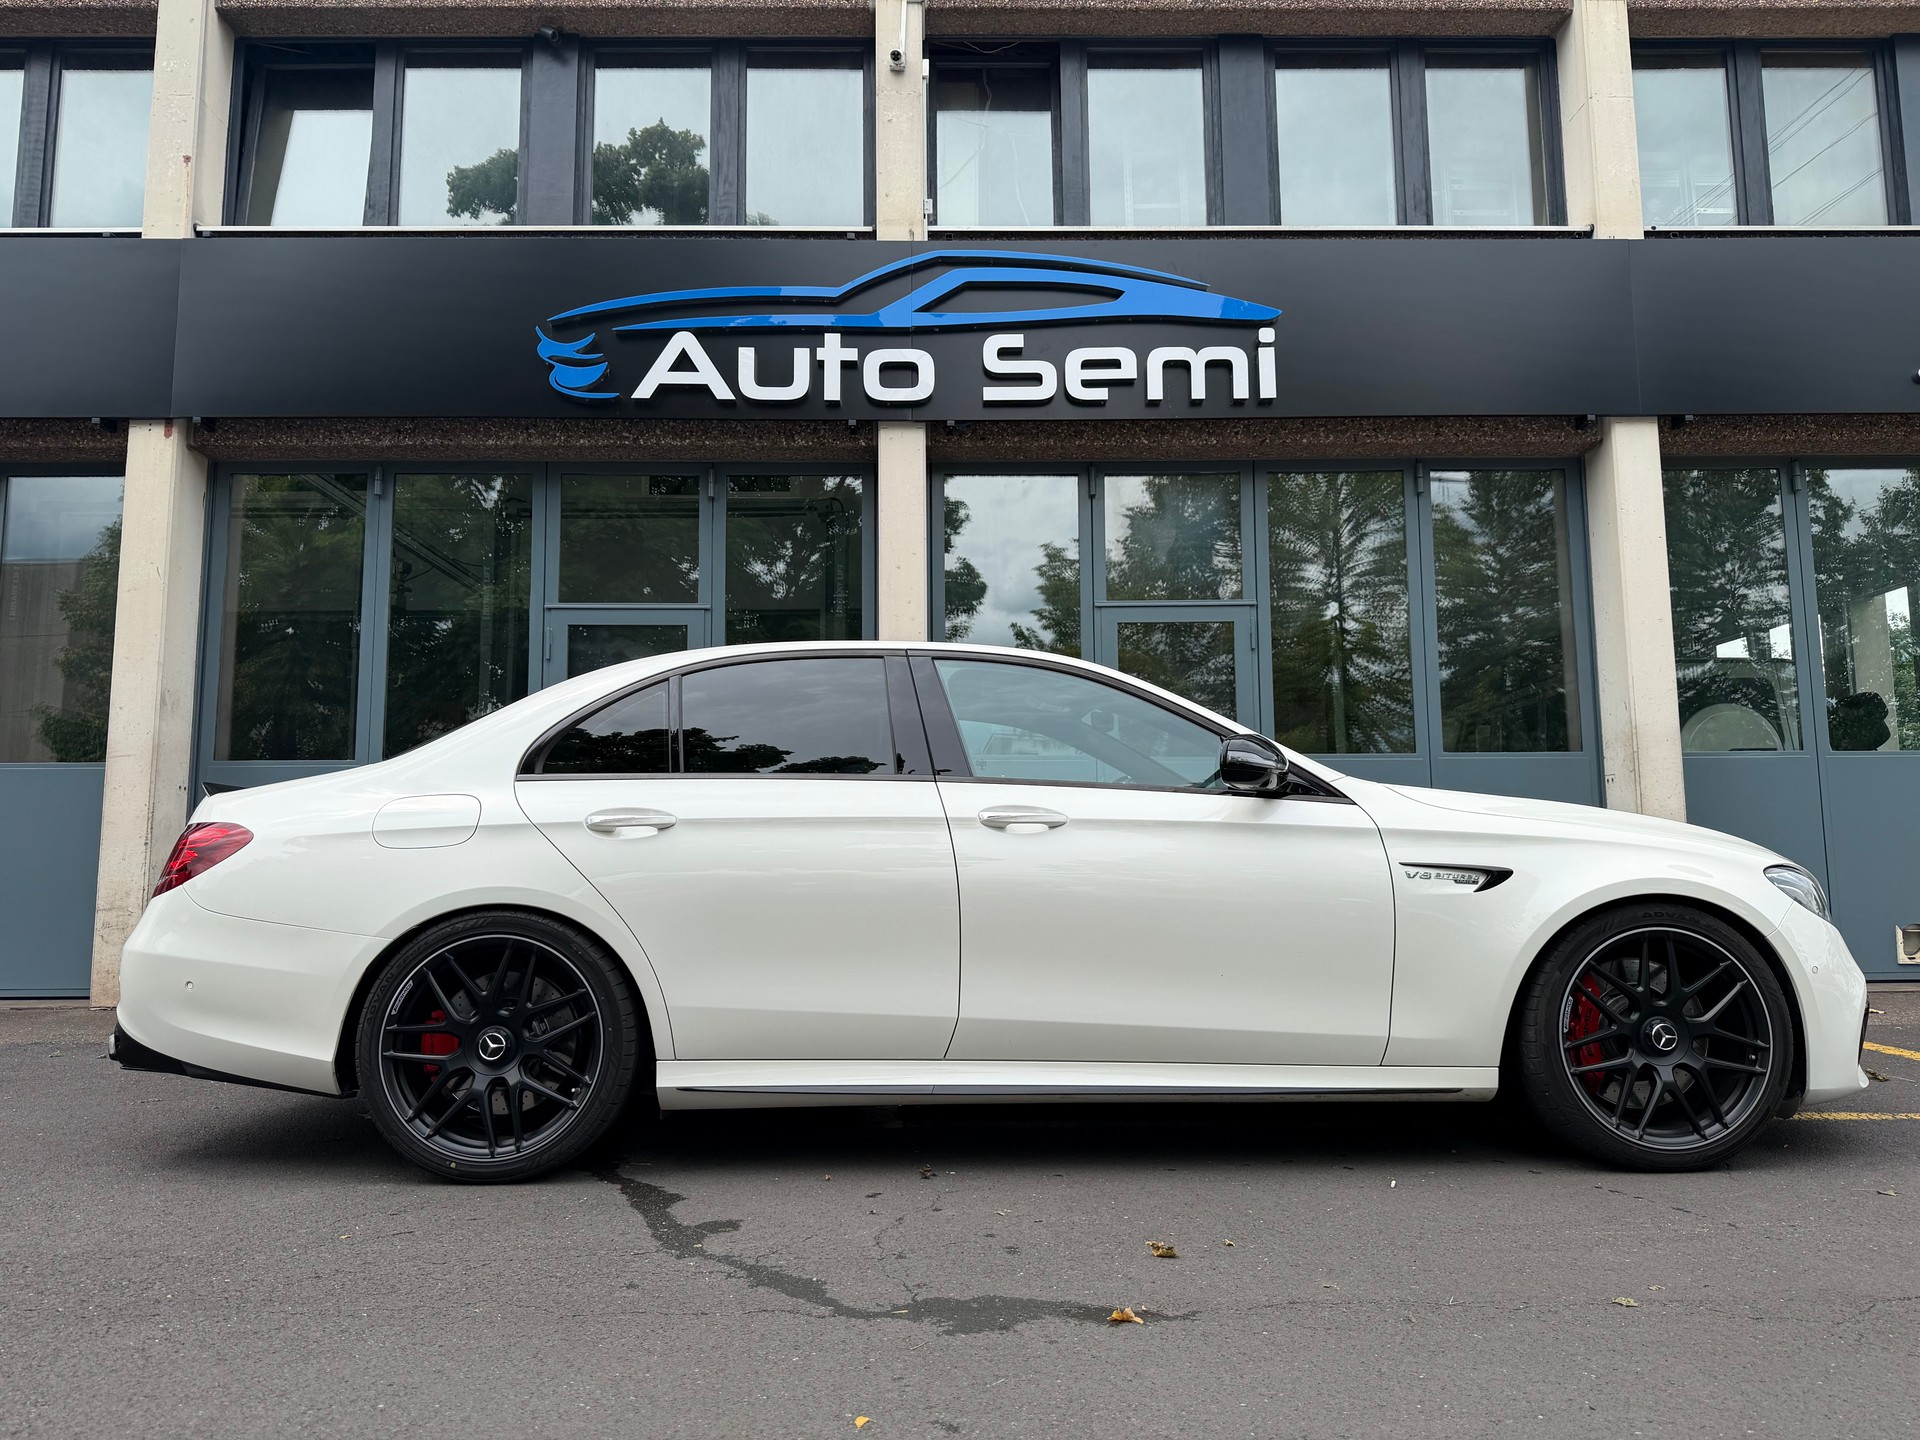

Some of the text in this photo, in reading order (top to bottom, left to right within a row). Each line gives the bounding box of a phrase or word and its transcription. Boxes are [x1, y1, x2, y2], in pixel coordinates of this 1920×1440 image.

[631, 327, 1277, 402] Auto Semi
[1405, 870, 1480, 881] V8 BITURBO
[1642, 911, 1700, 924] ADVAN
[366, 972, 394, 1024] ADVAN
